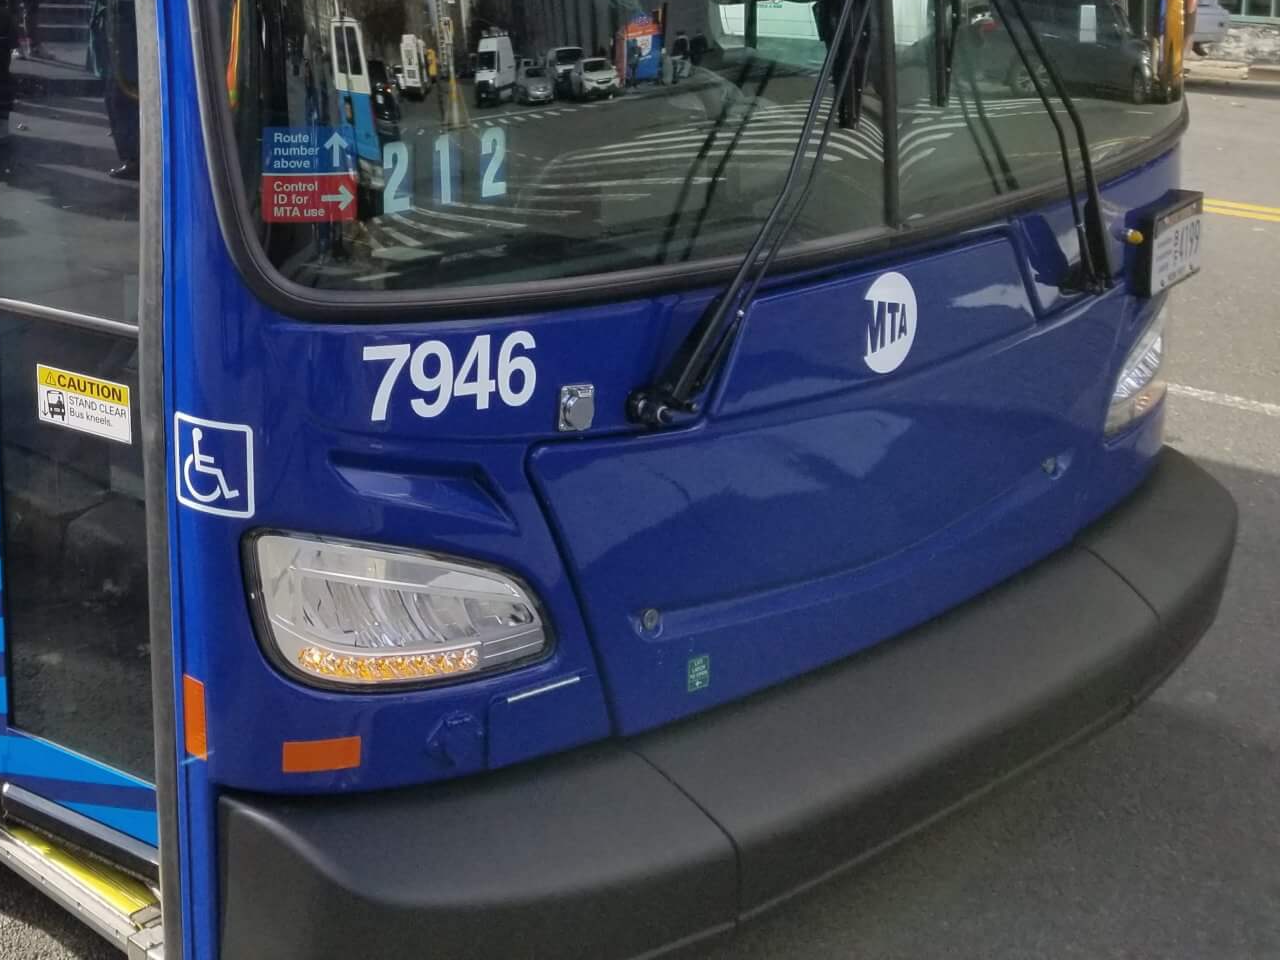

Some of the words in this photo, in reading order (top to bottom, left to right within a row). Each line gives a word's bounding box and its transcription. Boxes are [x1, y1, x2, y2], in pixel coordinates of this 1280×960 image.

[273, 132, 310, 144] Route
[273, 145, 320, 156] number
[273, 158, 311, 169] above
[273, 180, 319, 192] Control
[273, 193, 288, 205] ID
[291, 193, 309, 205] for
[273, 206, 301, 217] MTA
[303, 208, 326, 217] use
[863, 299, 908, 356] MTA
[363, 330, 537, 422] 7946
[57, 374, 122, 402] CAUTION
[68, 395, 98, 411] STAND
[99, 403, 127, 418] CLEAR
[69, 407, 84, 419] Bus
